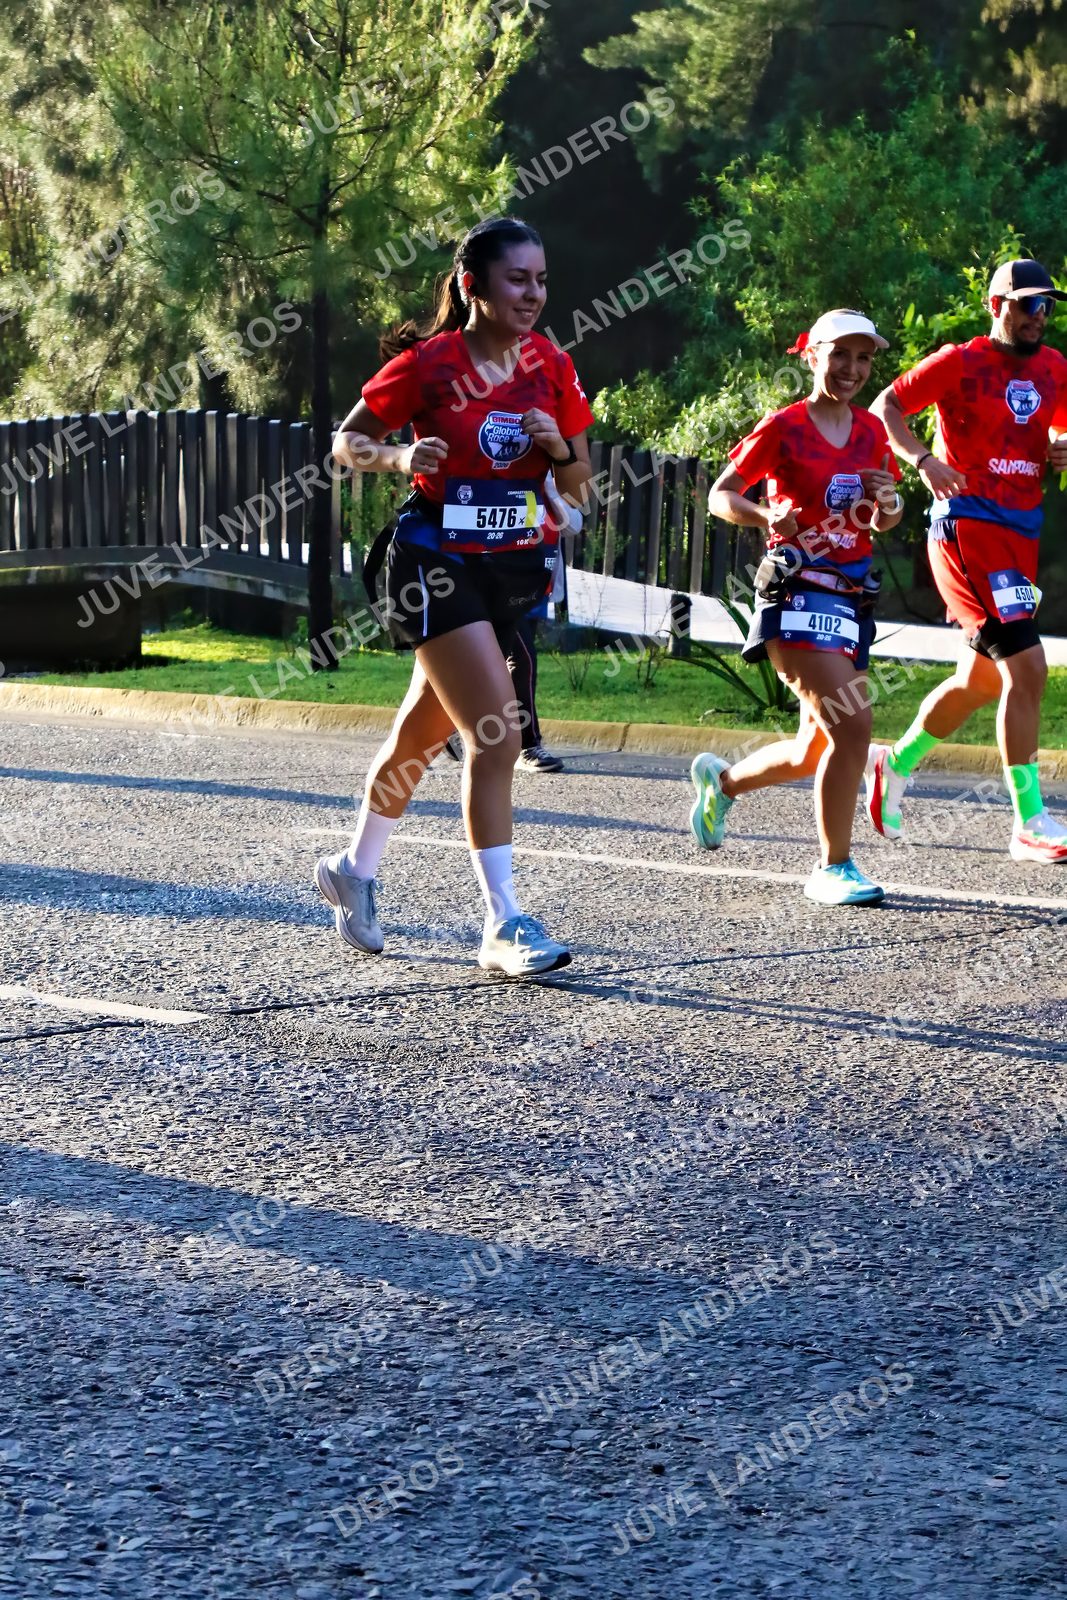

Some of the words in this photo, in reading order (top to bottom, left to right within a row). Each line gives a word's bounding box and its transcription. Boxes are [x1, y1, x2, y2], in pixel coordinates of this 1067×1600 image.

[492, 416, 520, 424] BIMBO
[493, 425, 520, 436] Global
[487, 432, 510, 442] Race
[476, 508, 517, 528] 5476
[808, 614, 841, 634] 4102
